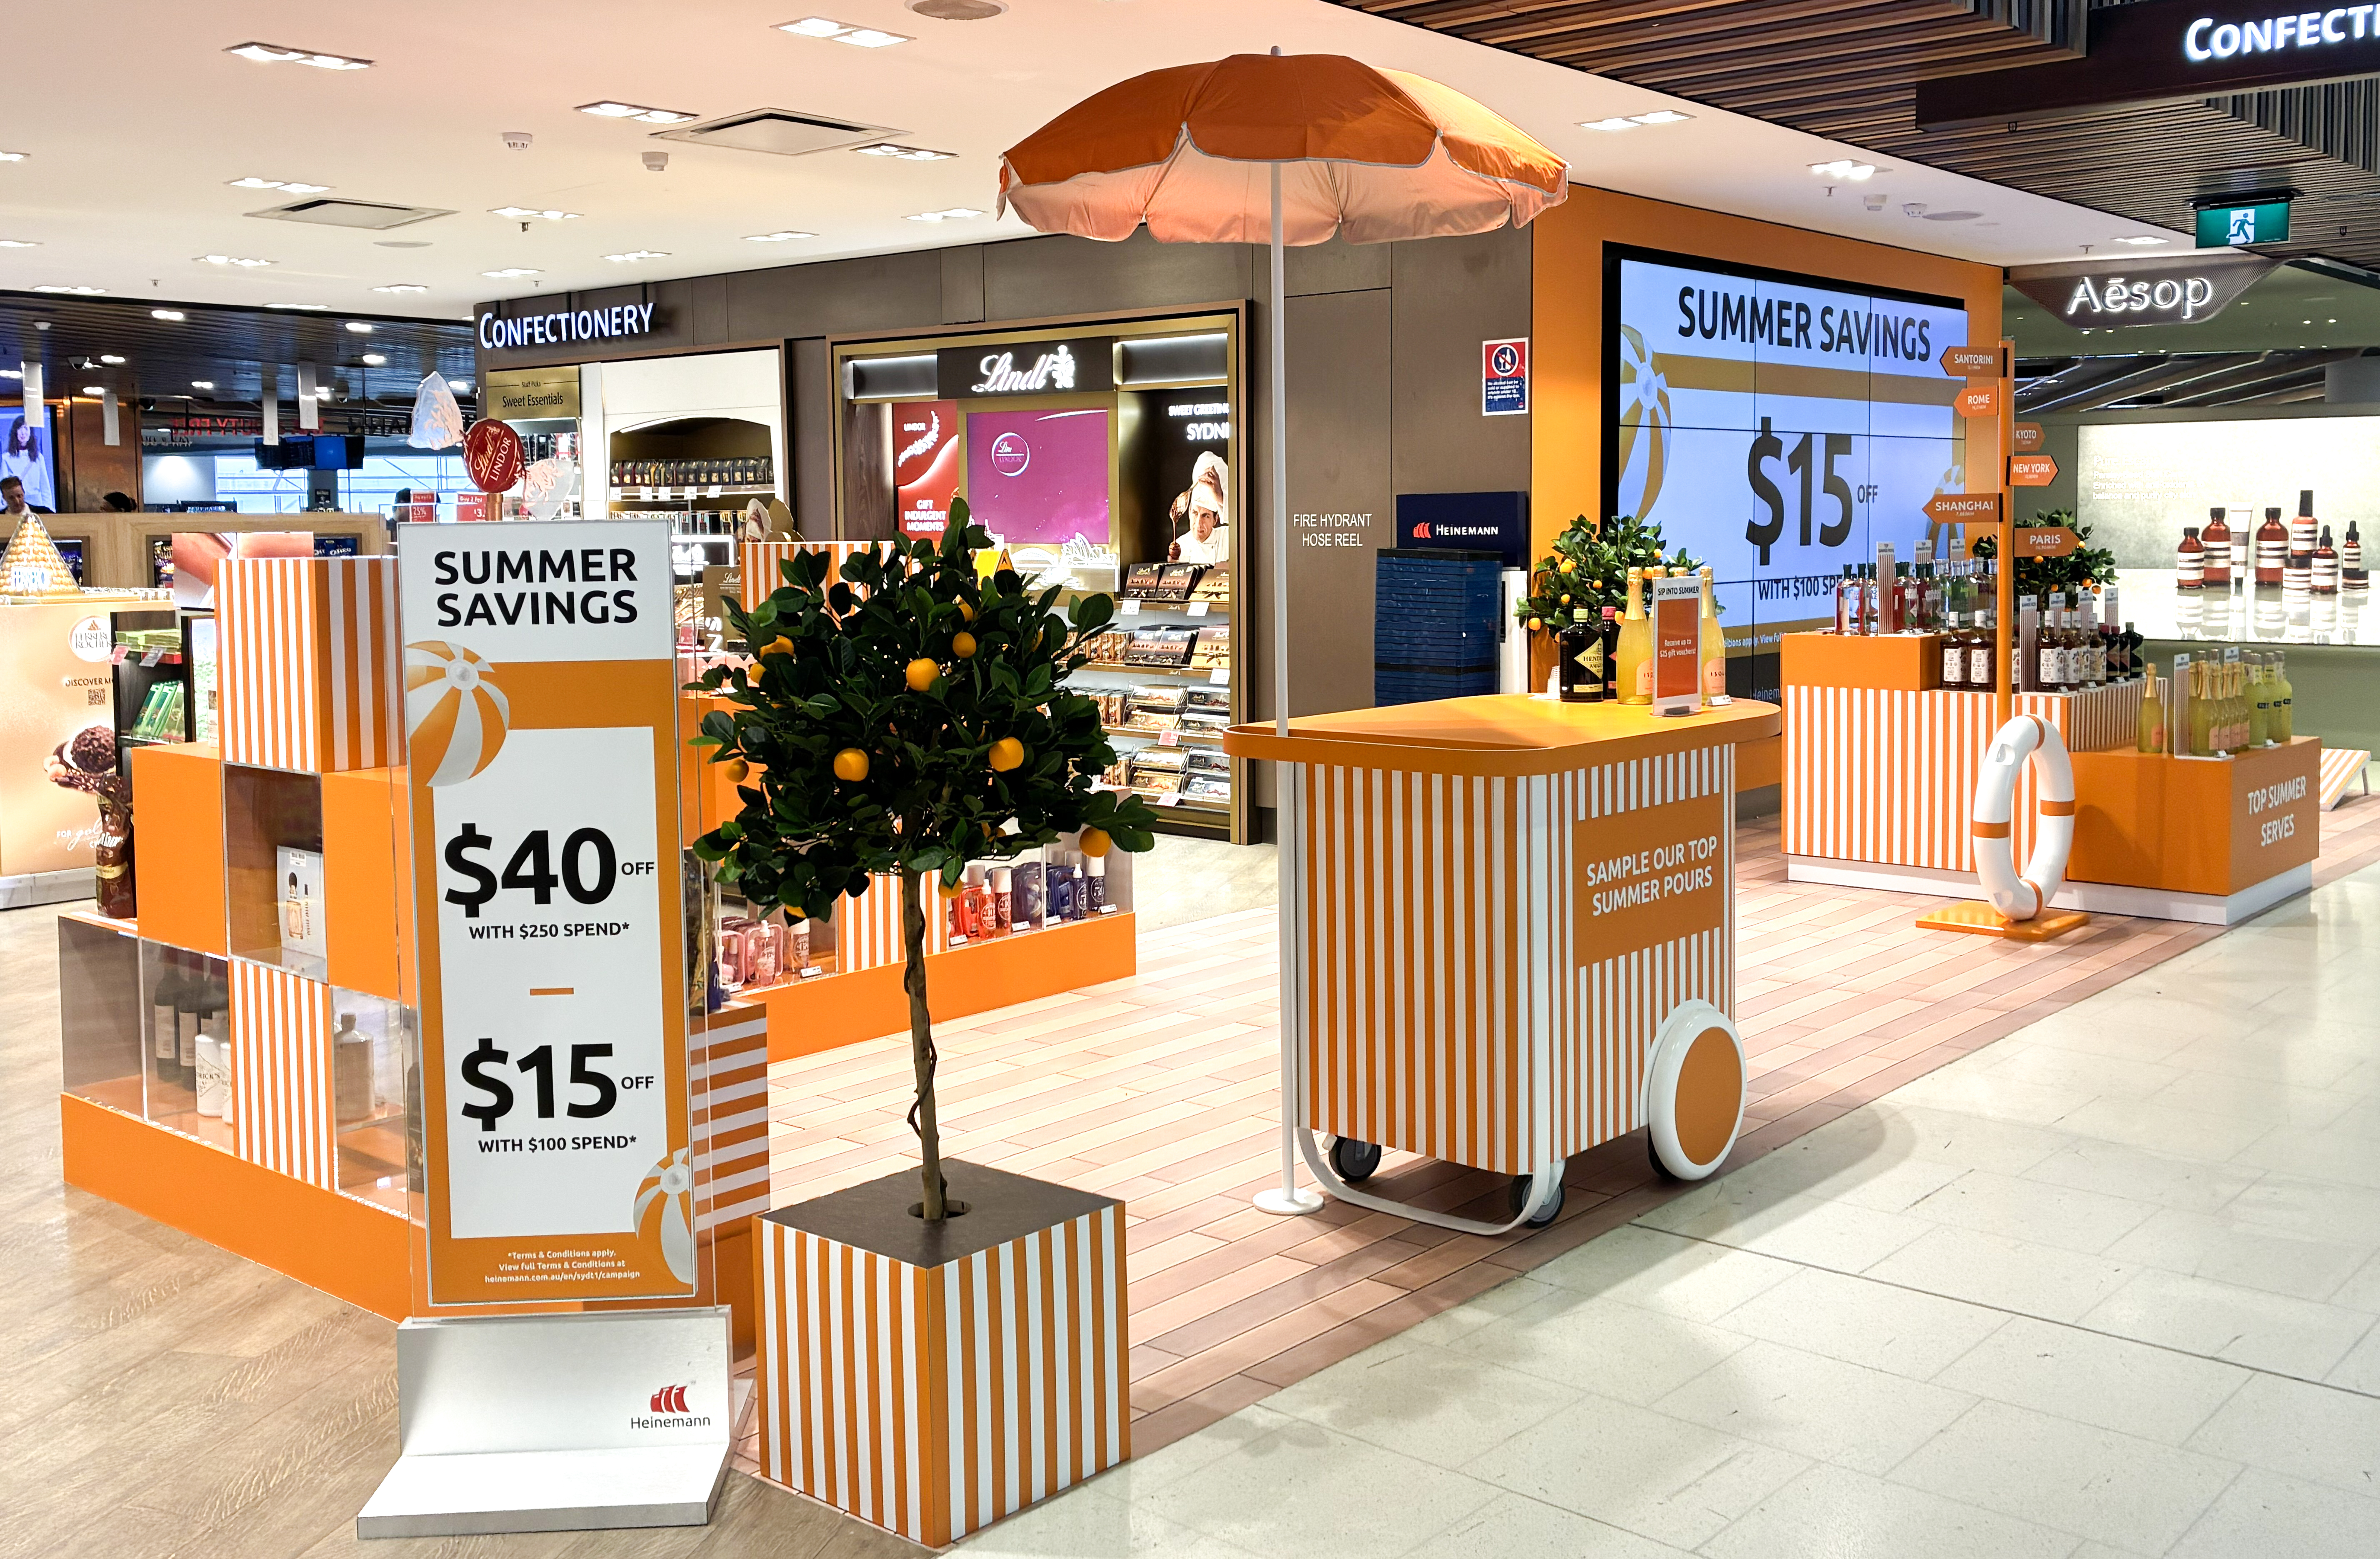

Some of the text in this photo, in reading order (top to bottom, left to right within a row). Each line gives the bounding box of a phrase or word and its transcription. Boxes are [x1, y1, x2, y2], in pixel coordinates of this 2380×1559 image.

[2067, 275, 2212, 319] Aēsop
[479, 302, 655, 349] CONFECTIONERY
[1678, 286, 1930, 362] SUMMER SAVINGS
[1954, 354, 1993, 365] SANTORINI
[971, 352, 1054, 392] Lindt
[502, 392, 563, 407] Sweet Essentials
[1968, 395, 1990, 405] ROME
[1168, 404, 1194, 416] SWEET
[1187, 422, 1230, 440] SYDN
[2016, 430, 2037, 439] KYOTO
[490, 437, 511, 482] LINDOR
[2013, 463, 2050, 473] NEW YORK
[1745, 416, 1878, 566] $15 OFF
[917, 500, 933, 510] GIFT
[1935, 501, 1993, 511] SHANGHAI
[904, 510, 946, 521] INDULGENT
[1293, 513, 1372, 527] FIRE HYDRANT
[907, 522, 944, 532] MOMENTS
[1302, 533, 1363, 547] HOSE REEL
[2030, 534, 2061, 545] PARIS
[434, 548, 638, 585] SUMMER
[1758, 578, 1790, 600] WITH
[1793, 575, 1819, 600] $100
[437, 590, 638, 627] SAVINGS
[65, 678, 103, 687] DISCOVER
[2248, 775, 2306, 815] TOP SUMMER
[56, 829, 72, 838] FOR
[2260, 813, 2295, 847] SERVES
[1587, 836, 1717, 887] SAMPLE OUR TOP
[444, 823, 655, 918] $40 OFF
[1593, 865, 1712, 916] SUMMER POURS
[469, 924, 514, 939] WITH
[519, 924, 559, 940] $250
[461, 1037, 654, 1132] $15 OFF
[478, 1138, 523, 1153] WITH
[528, 1137, 566, 1153] $100
[546, 1249, 590, 1258] Conditions
[592, 1249, 616, 1258] apply.
[537, 1262, 561, 1270] Terms
[571, 1260, 615, 1269] Conditions
[631, 1416, 711, 1429] Heinemann
